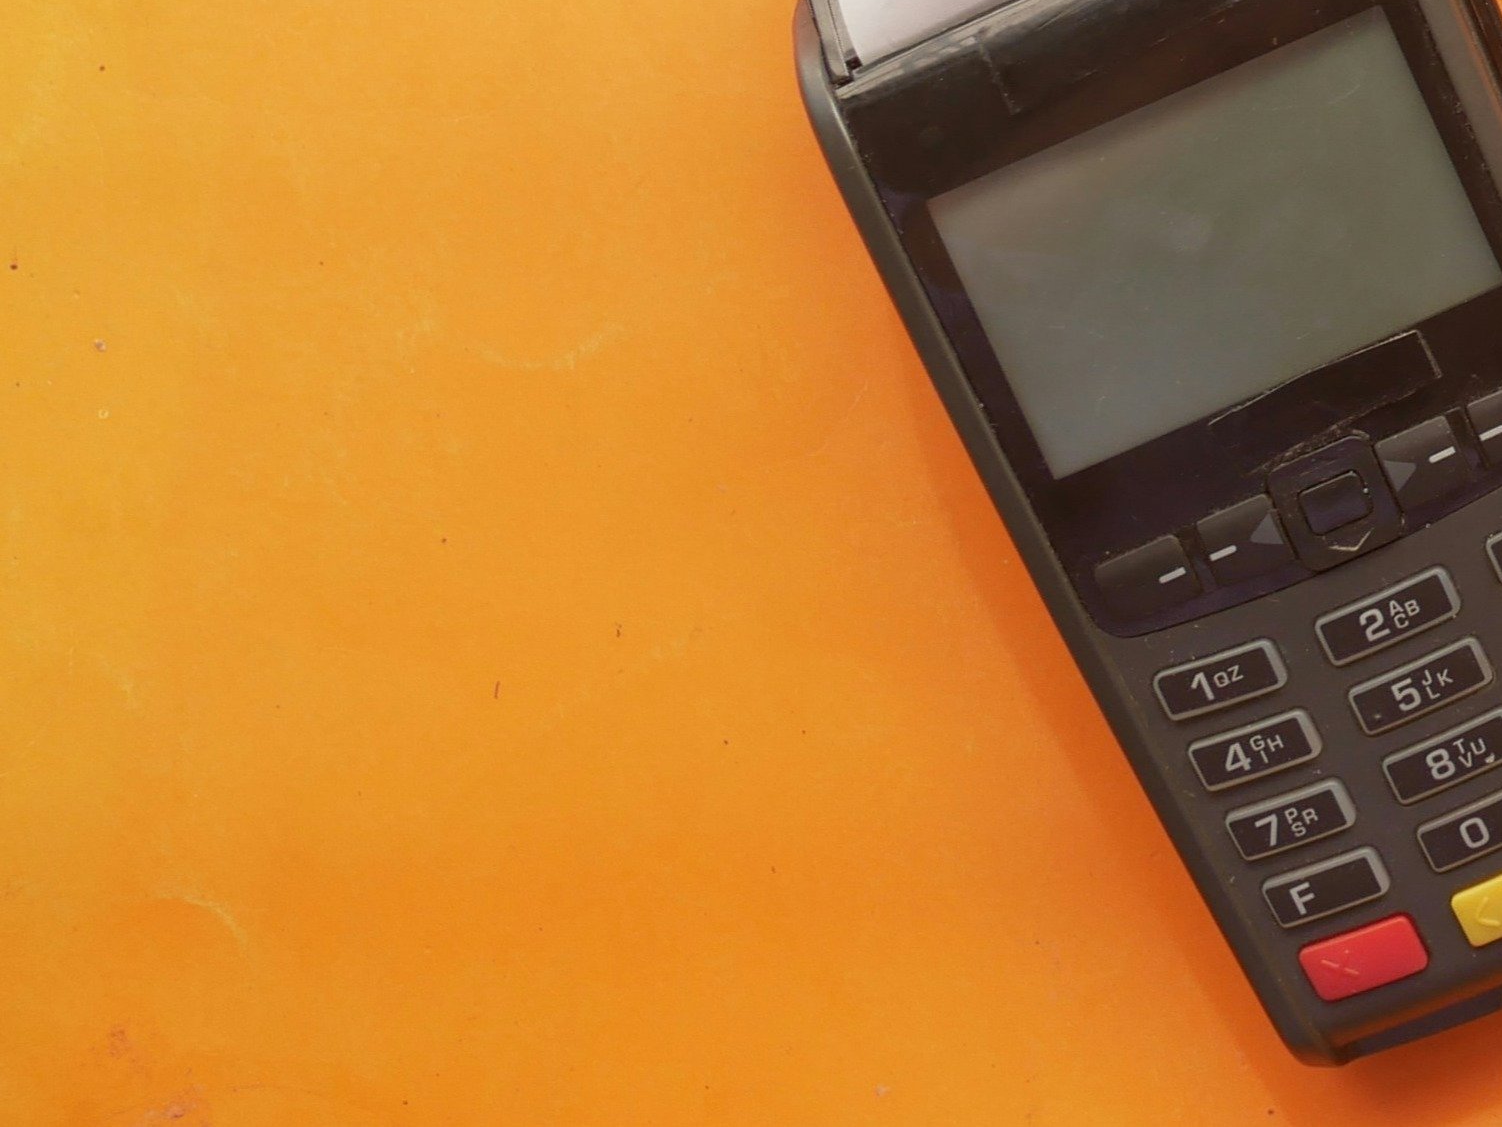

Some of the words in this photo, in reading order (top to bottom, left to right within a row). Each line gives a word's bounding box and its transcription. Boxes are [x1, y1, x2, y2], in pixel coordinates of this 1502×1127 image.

[1358, 608, 1391, 642] 2
[1190, 671, 1216, 701] 1
[1390, 677, 1422, 712] 5
[1224, 741, 1252, 772] 4
[1425, 747, 1456, 780] 8
[1253, 813, 1279, 847] 7
[1288, 881, 1316, 916] F
